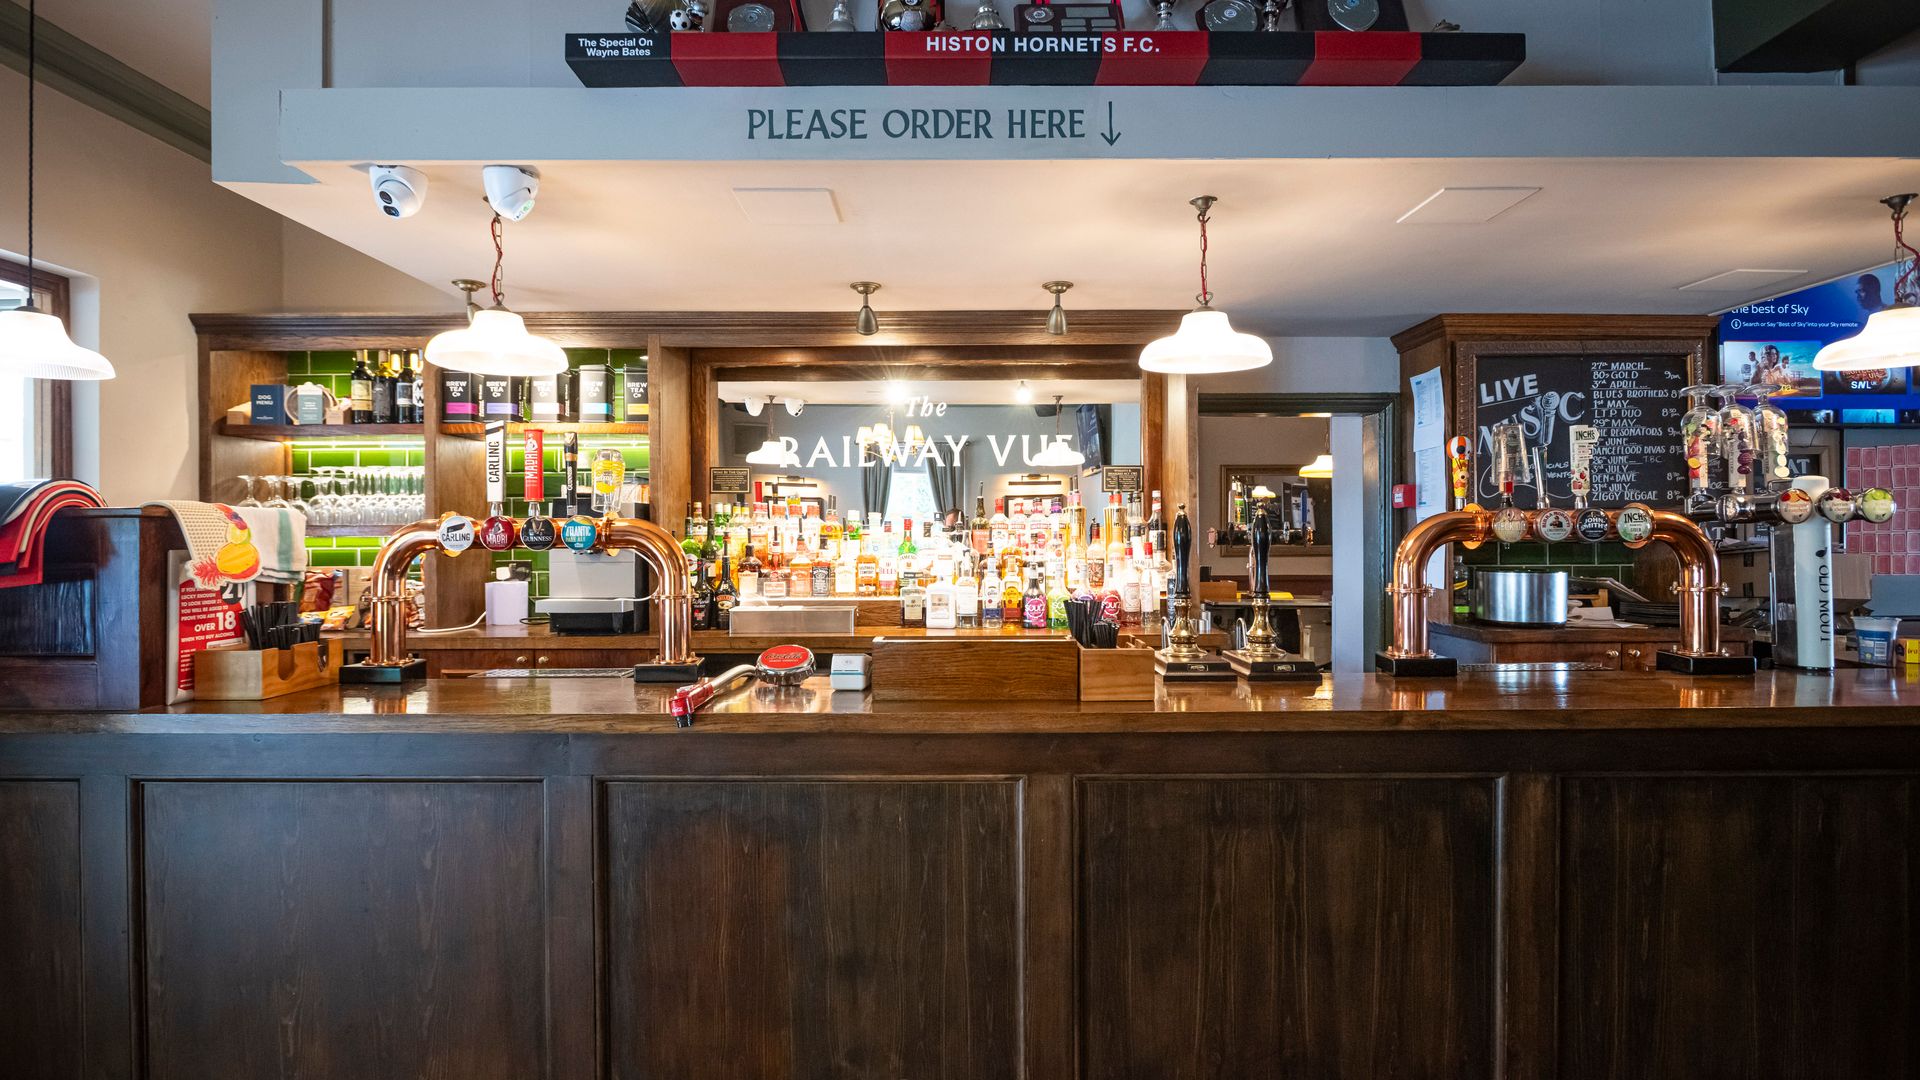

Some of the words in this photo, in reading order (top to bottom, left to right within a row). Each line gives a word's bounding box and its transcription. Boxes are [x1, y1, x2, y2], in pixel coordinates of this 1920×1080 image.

[578, 38, 597, 47] The
[599, 37, 636, 49] Special
[638, 37, 653, 47] On
[926, 36, 1005, 52] HISTON
[1014, 37, 1117, 53] HORNETS
[1123, 37, 1160, 53] F.C.
[586, 48, 620, 58] Wayne
[622, 47, 651, 57] Bates
[747, 109, 868, 140] PLEASE
[882, 109, 994, 140] ORDER
[1007, 109, 1086, 139] HERE
[1751, 305, 1776, 314] best
[1777, 304, 1790, 314] of
[1791, 304, 1809, 316] Sky
[1610, 371, 1639, 379] GOLD
[1480, 373, 1539, 405] LIVE
[1851, 381, 1871, 390] SNL
[1593, 389, 1623, 399] BLUES
[1626, 389, 1669, 398] BROTHERS
[905, 395, 948, 418] The
[1621, 409, 1642, 418] DUO
[1610, 427, 1663, 437] RESONATORS
[779, 435, 969, 468] RAILWAY
[1643, 446, 1666, 454] DIVAS
[488, 441, 500, 483] CARLING
[1592, 474, 1609, 483] DEN
[1615, 473, 1638, 482] DAVE
[1592, 491, 1621, 501] ZIGGY
[1624, 490, 1659, 500] REGGAE
[566, 525, 591, 537] ATLANTIC
[442, 533, 471, 542] CARLING
[1818, 565, 1830, 593] OLD
[216, 610, 237, 631] 18
[1818, 600, 1831, 642] MOUT
[194, 622, 216, 632] OVER
